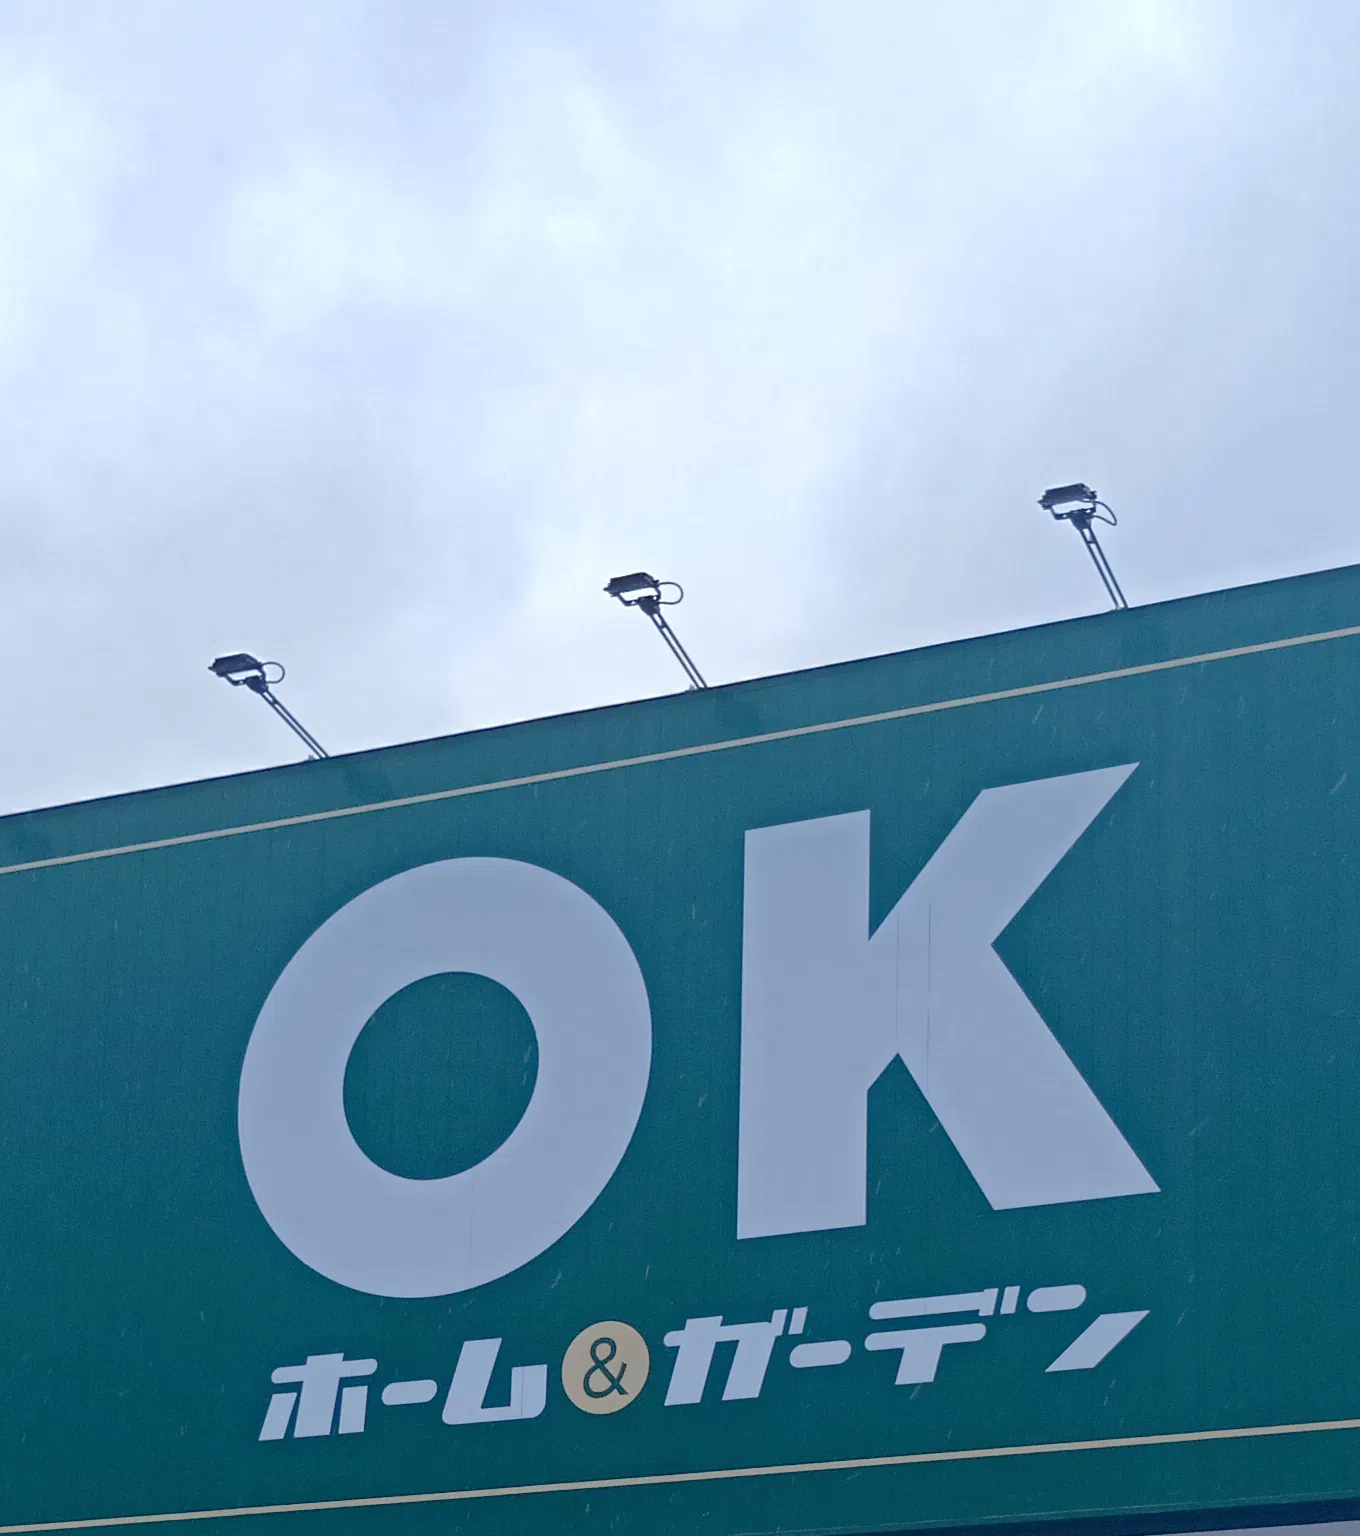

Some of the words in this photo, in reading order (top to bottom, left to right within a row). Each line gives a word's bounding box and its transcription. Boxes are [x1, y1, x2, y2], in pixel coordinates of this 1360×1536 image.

[238, 761, 1161, 1299] OK
[258, 1284, 1150, 1441] ホーム&ガーデン
